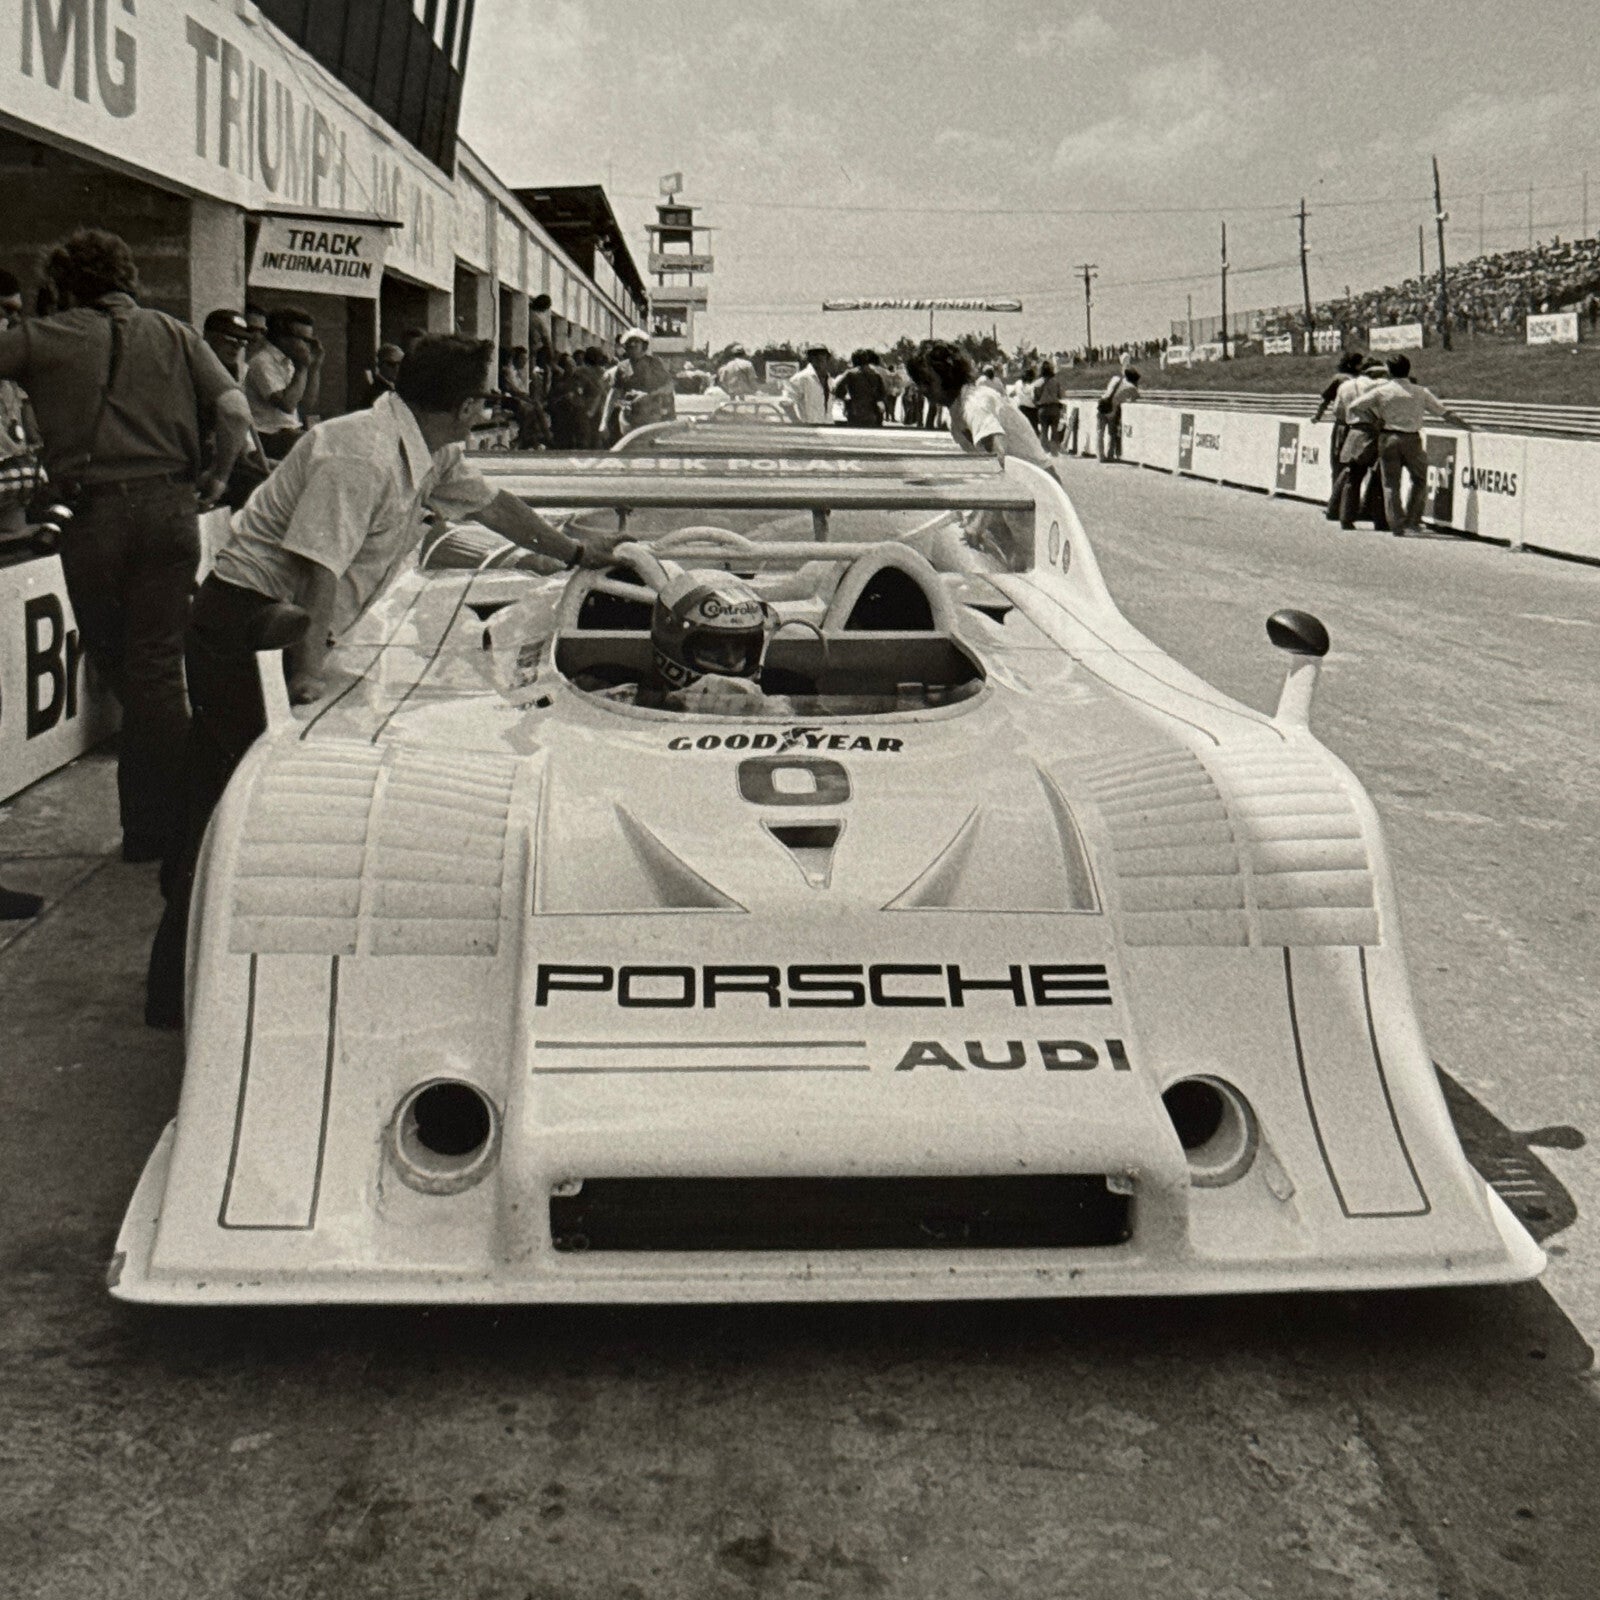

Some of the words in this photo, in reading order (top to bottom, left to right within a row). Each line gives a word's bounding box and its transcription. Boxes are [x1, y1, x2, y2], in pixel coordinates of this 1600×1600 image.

[20, 0, 138, 119] MG
[185, 14, 347, 212] TRIUMPH
[288, 229, 363, 257] TRACK
[262, 251, 373, 279] INFORMATION
[1195, 432, 1221, 451] CAMERAS
[1301, 446, 1320, 465] FILM
[567, 457, 708, 471] VASEK
[728, 459, 865, 473] POLAK
[1461, 466, 1518, 497] CAMERAS
[534, 963, 1113, 1008] PORSCHE
[894, 1039, 1132, 1071] AUDI
